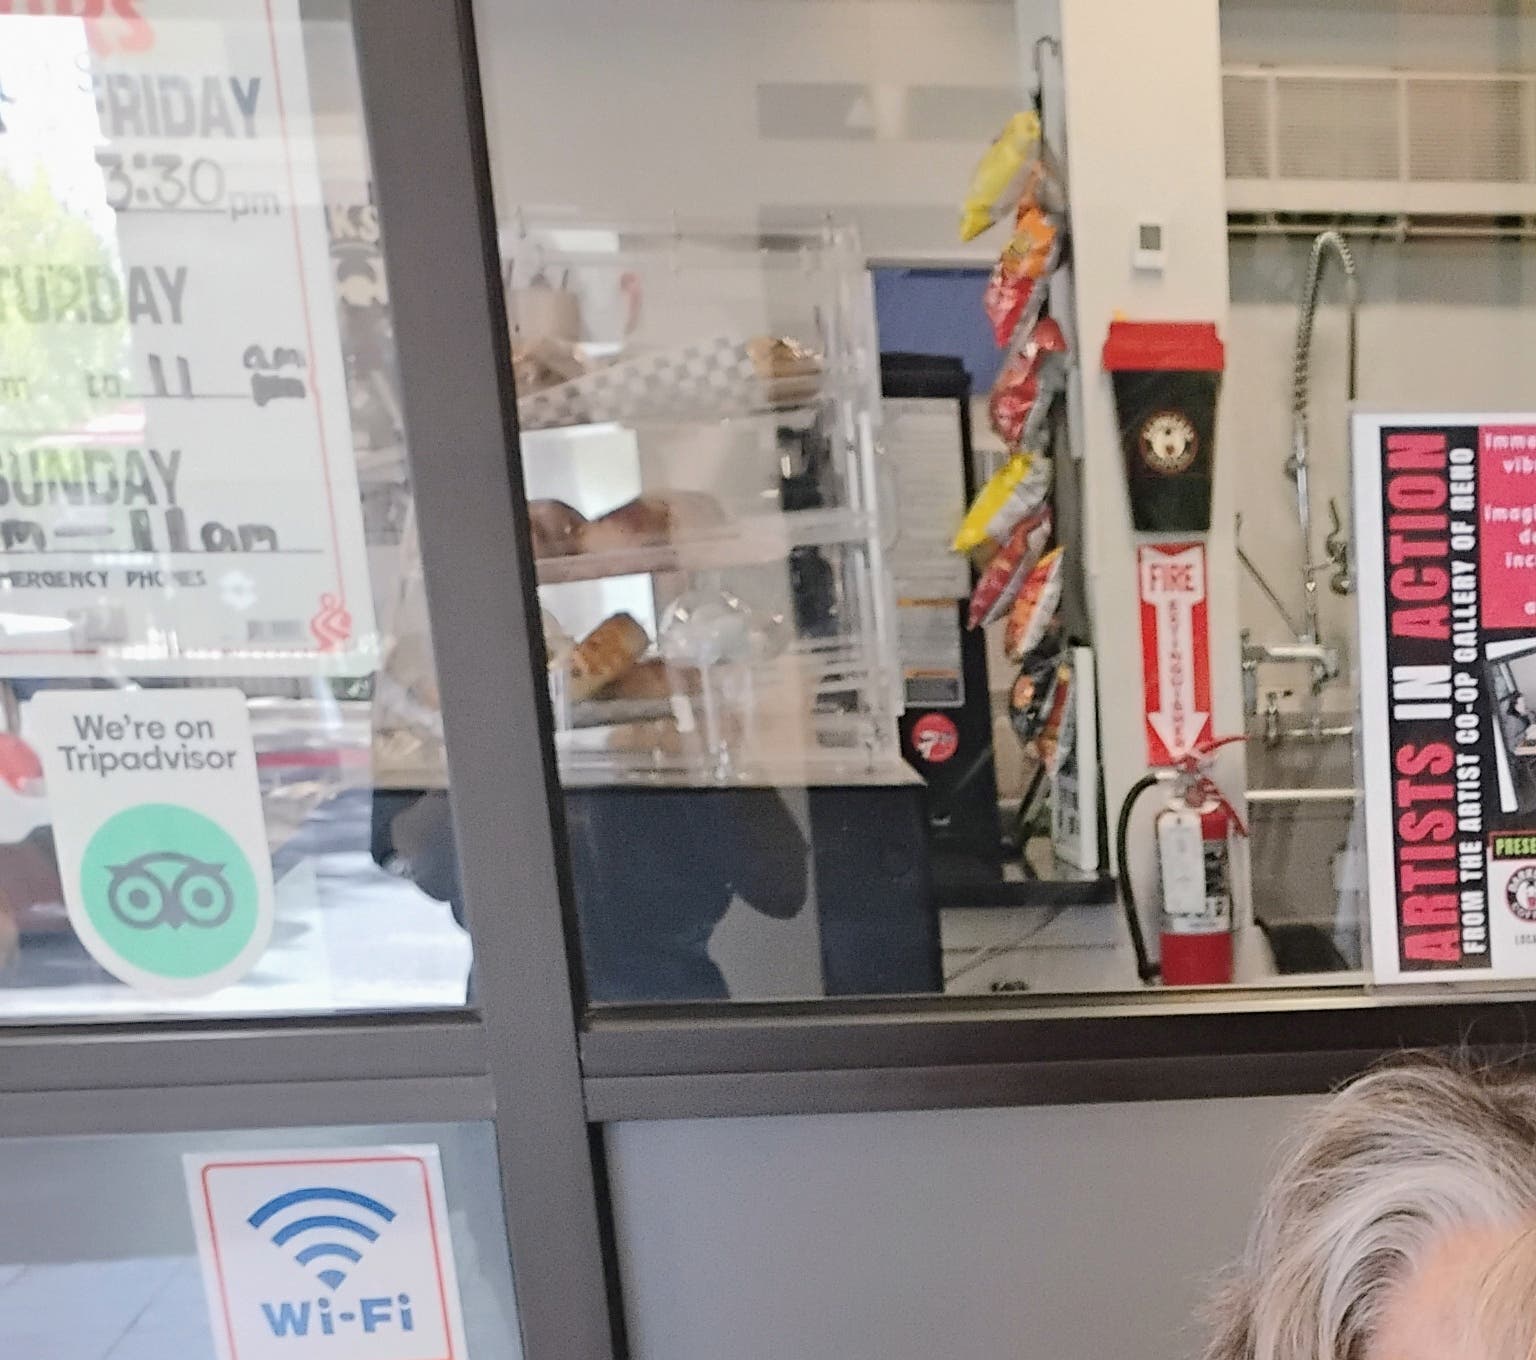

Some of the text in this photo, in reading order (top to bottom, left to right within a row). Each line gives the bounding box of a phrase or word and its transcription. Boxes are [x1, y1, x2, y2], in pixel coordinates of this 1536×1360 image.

[230, 191, 282, 222] pm
[1149, 562, 1195, 593] FIRE
[1386, 432, 1461, 962] ARTISTS IN ACTION
[1446, 446, 1489, 956] FROM THE ARTIST CO-OP GALLERY OF RENO
[73, 713, 215, 742] We're on
[57, 744, 238, 779] Tripadvisor
[260, 1292, 415, 1337] Wi-Fi
